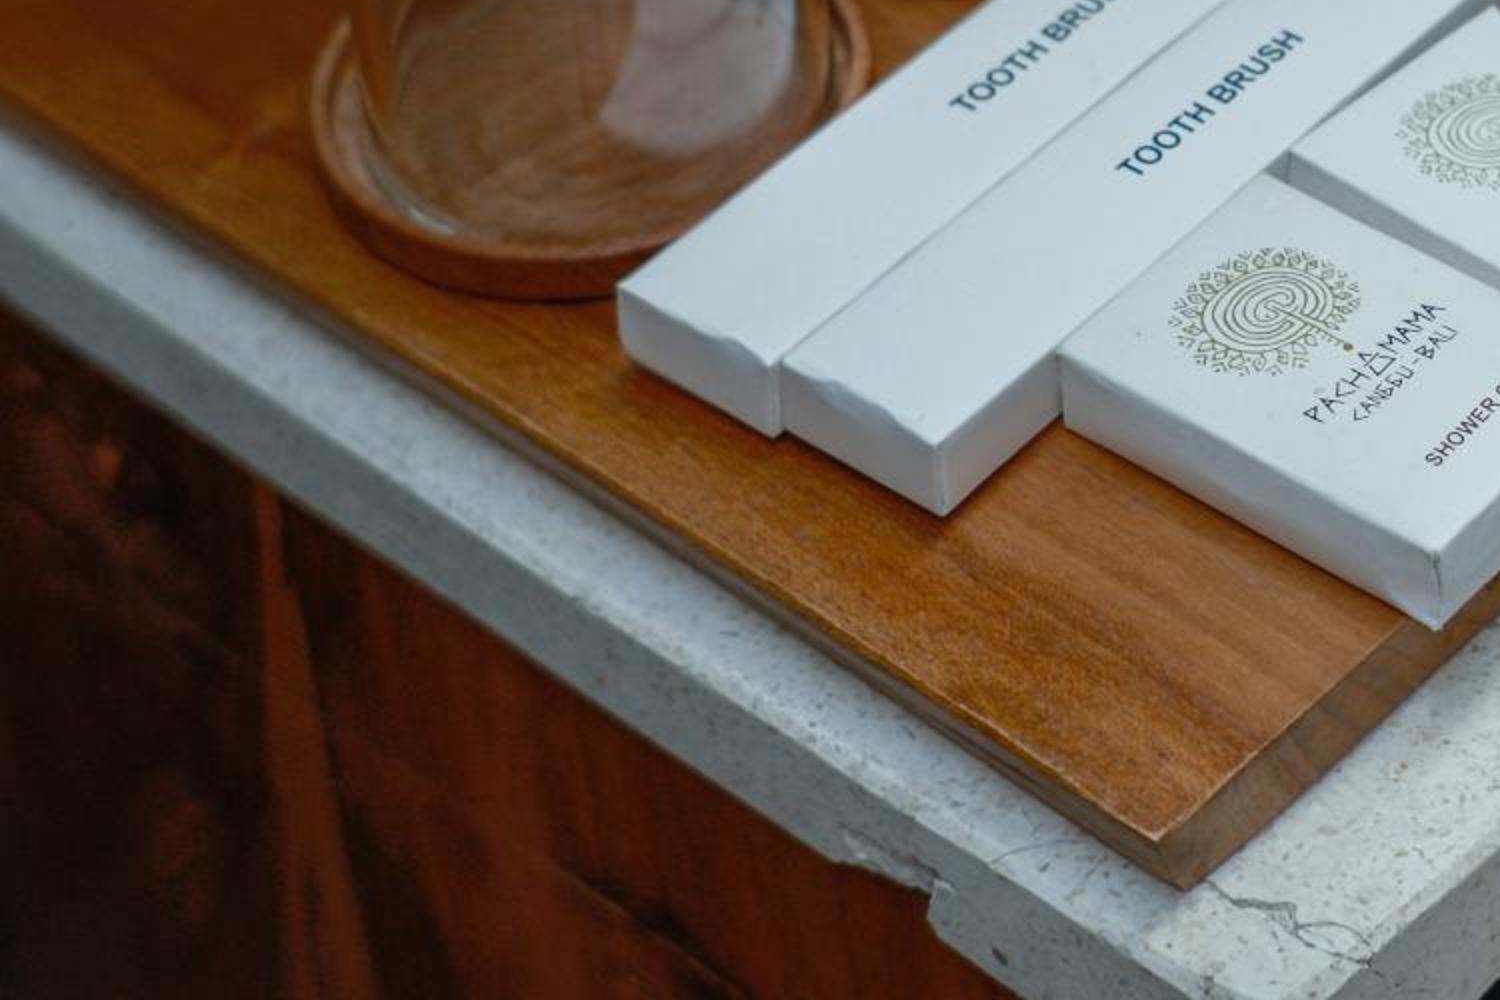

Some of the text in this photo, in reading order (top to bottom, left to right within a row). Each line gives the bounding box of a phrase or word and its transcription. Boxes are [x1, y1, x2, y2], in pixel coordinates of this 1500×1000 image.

[950, 40, 1049, 112] TOOTH
[1116, 30, 1304, 177] TOOTH BRUSH
[1303, 303, 1446, 424] PACHAMAMA
[1425, 397, 1500, 467] SHOWER
